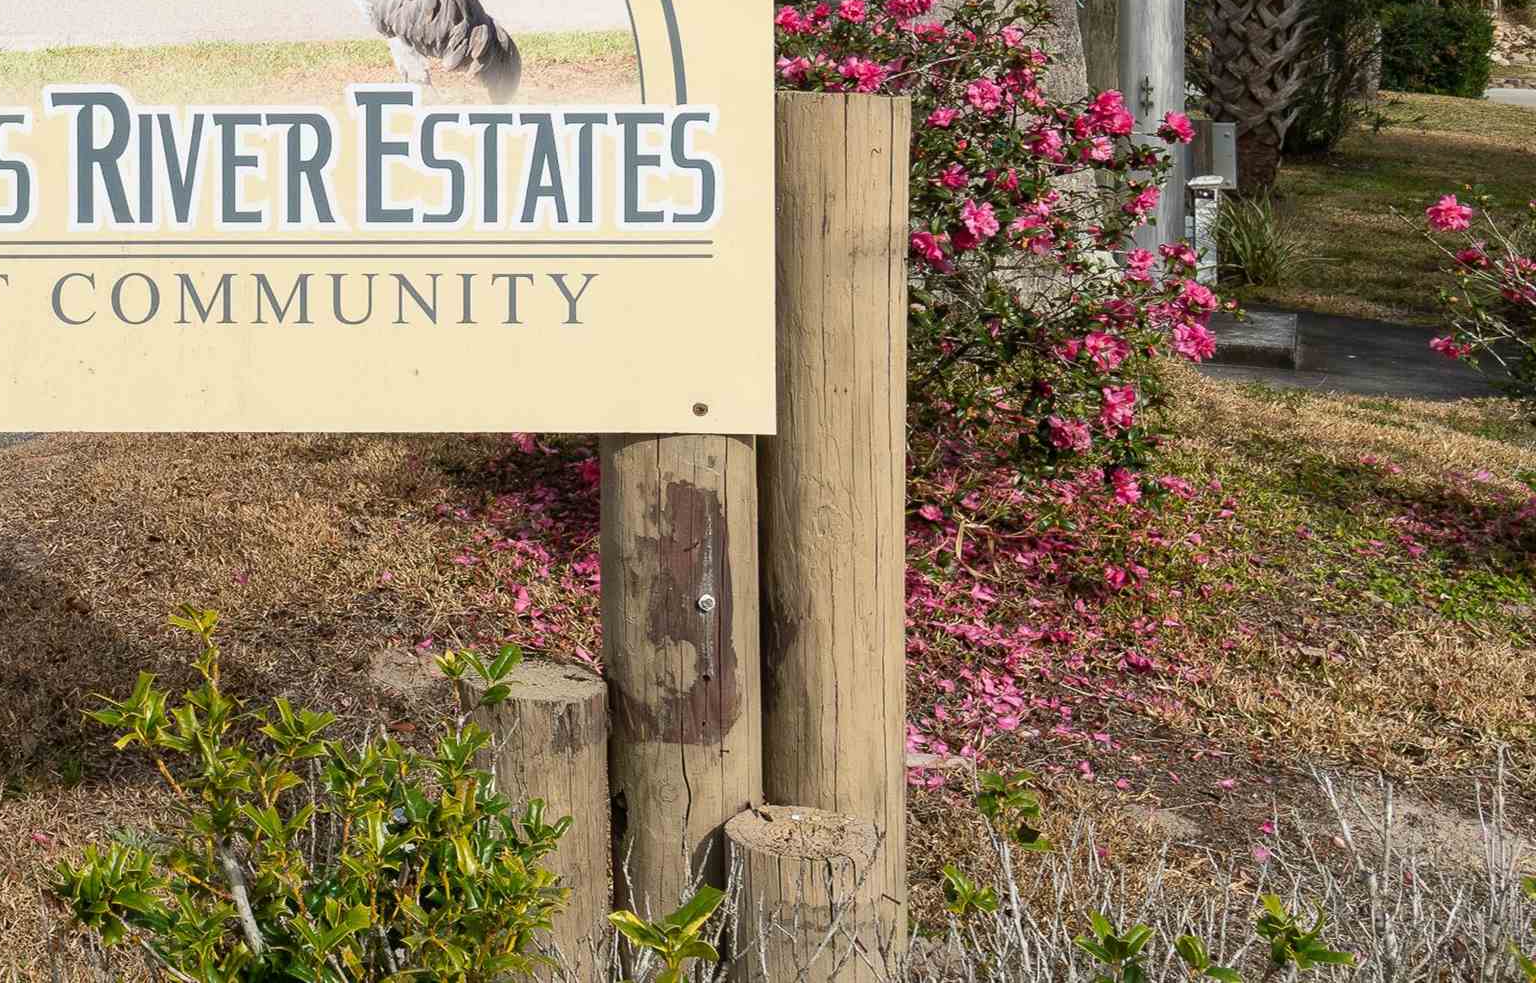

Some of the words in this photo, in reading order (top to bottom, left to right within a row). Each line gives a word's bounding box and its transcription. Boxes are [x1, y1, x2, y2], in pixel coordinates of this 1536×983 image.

[50, 92, 339, 224] RIVER
[354, 91, 718, 224] ESTATES
[49, 272, 601, 326] COMMUNITY
